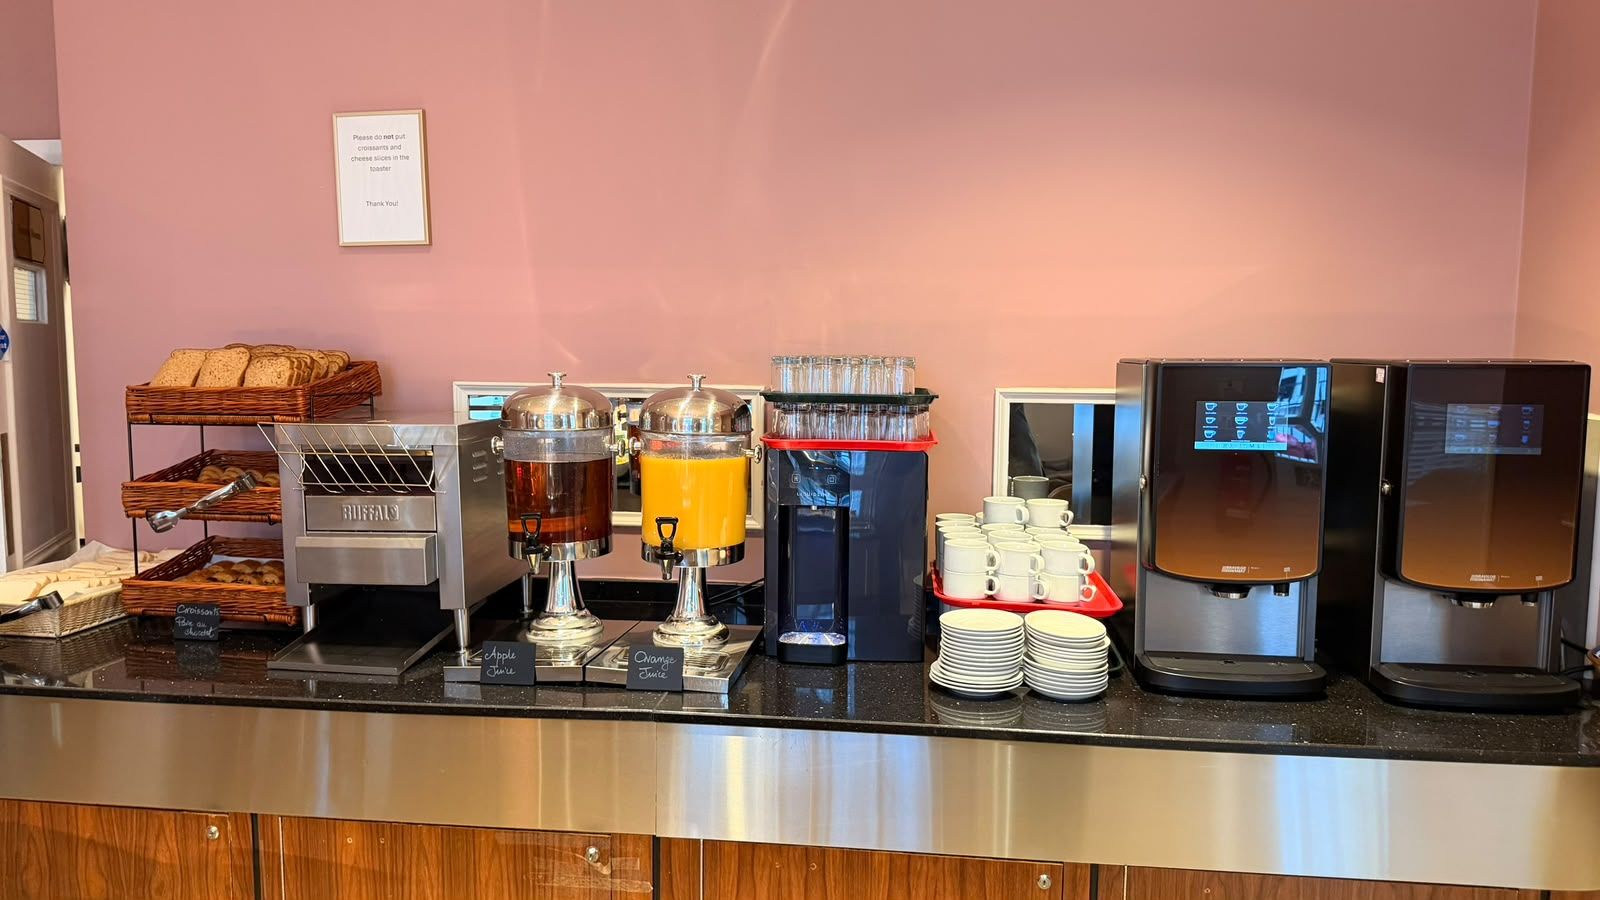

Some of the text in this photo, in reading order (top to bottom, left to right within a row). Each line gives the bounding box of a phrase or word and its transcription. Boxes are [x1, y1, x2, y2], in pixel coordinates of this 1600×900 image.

[342, 504, 400, 521] BUFFALO
[485, 646, 517, 667] Apple
[635, 651, 677, 671] Orange
[487, 666, 516, 677] Juice
[639, 667, 668, 680] Juice
